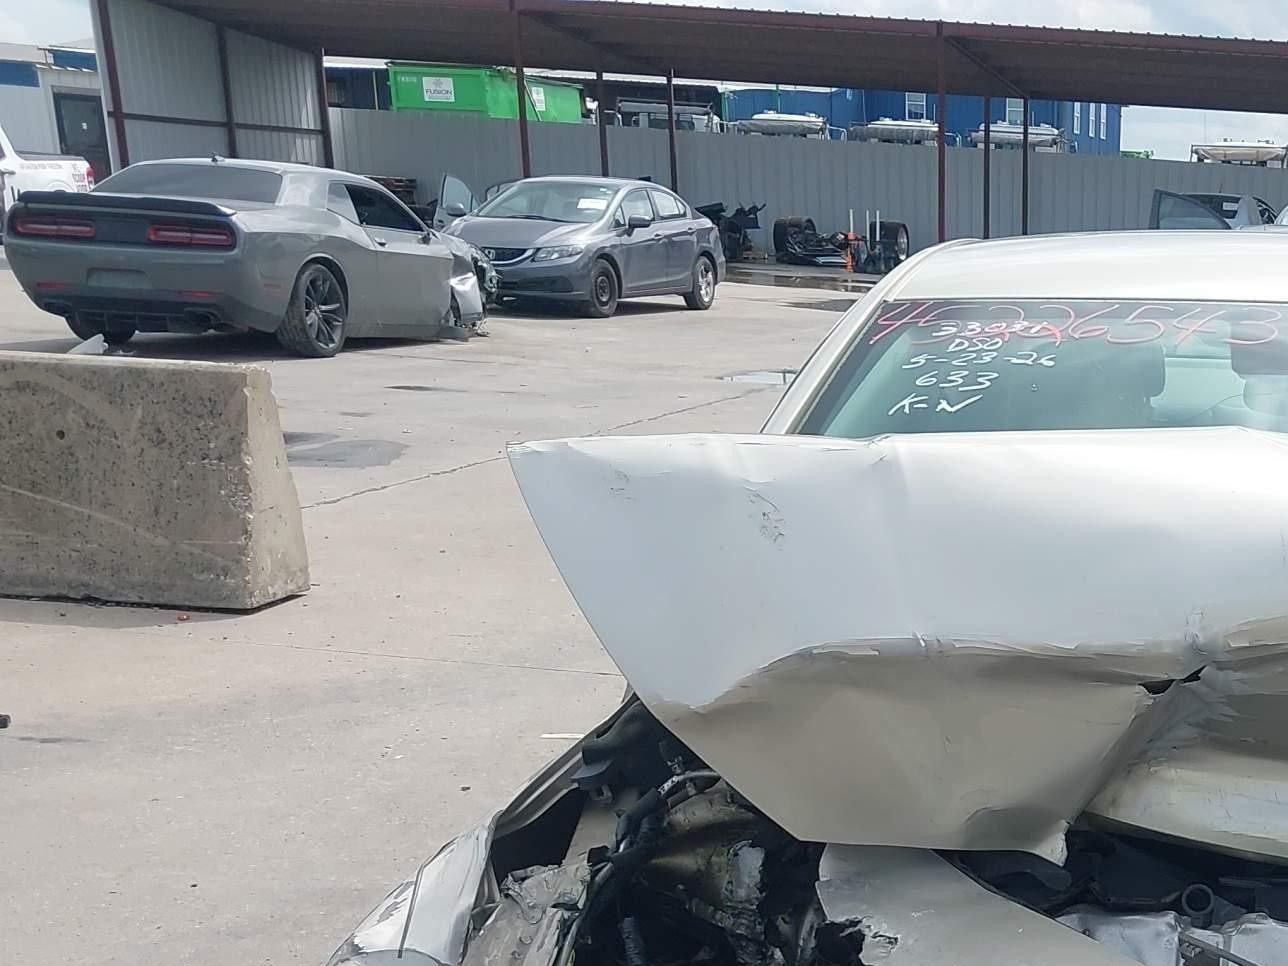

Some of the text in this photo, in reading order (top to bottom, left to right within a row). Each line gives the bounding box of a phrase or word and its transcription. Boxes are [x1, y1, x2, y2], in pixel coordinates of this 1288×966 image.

[425, 88, 453, 96] FUSION
[868, 300, 1283, 347] 45226543
[915, 370, 1000, 392] 633
